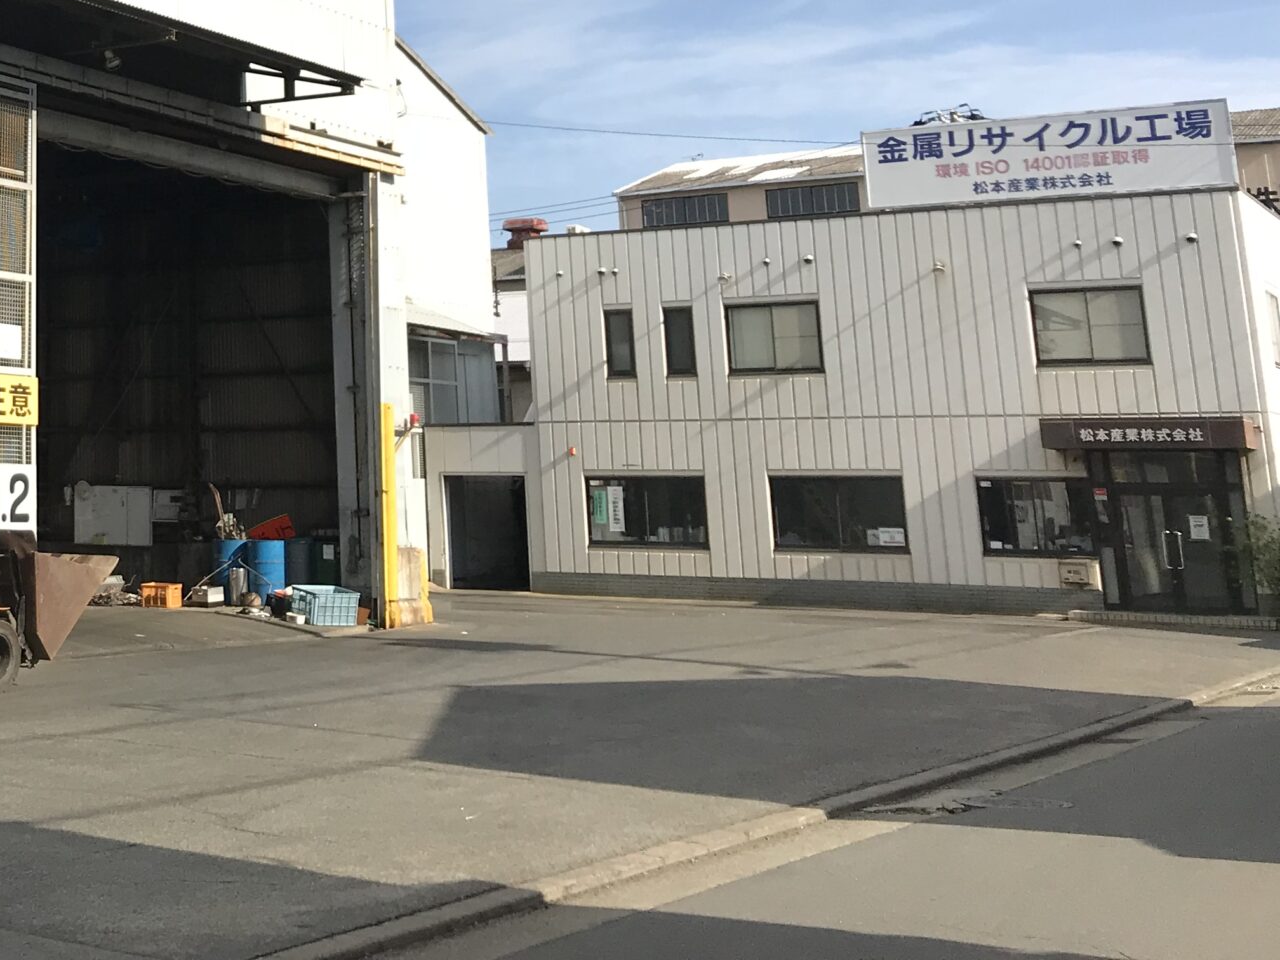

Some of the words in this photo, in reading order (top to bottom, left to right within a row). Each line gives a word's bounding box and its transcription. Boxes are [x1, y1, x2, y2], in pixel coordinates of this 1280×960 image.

[877, 109, 1213, 164] 金属リサイクル工場
[976, 159, 1010, 176] ISO
[973, 171, 1114, 195] 松本産業株式会社
[1079, 427, 1204, 442] 松本産業株式会社
